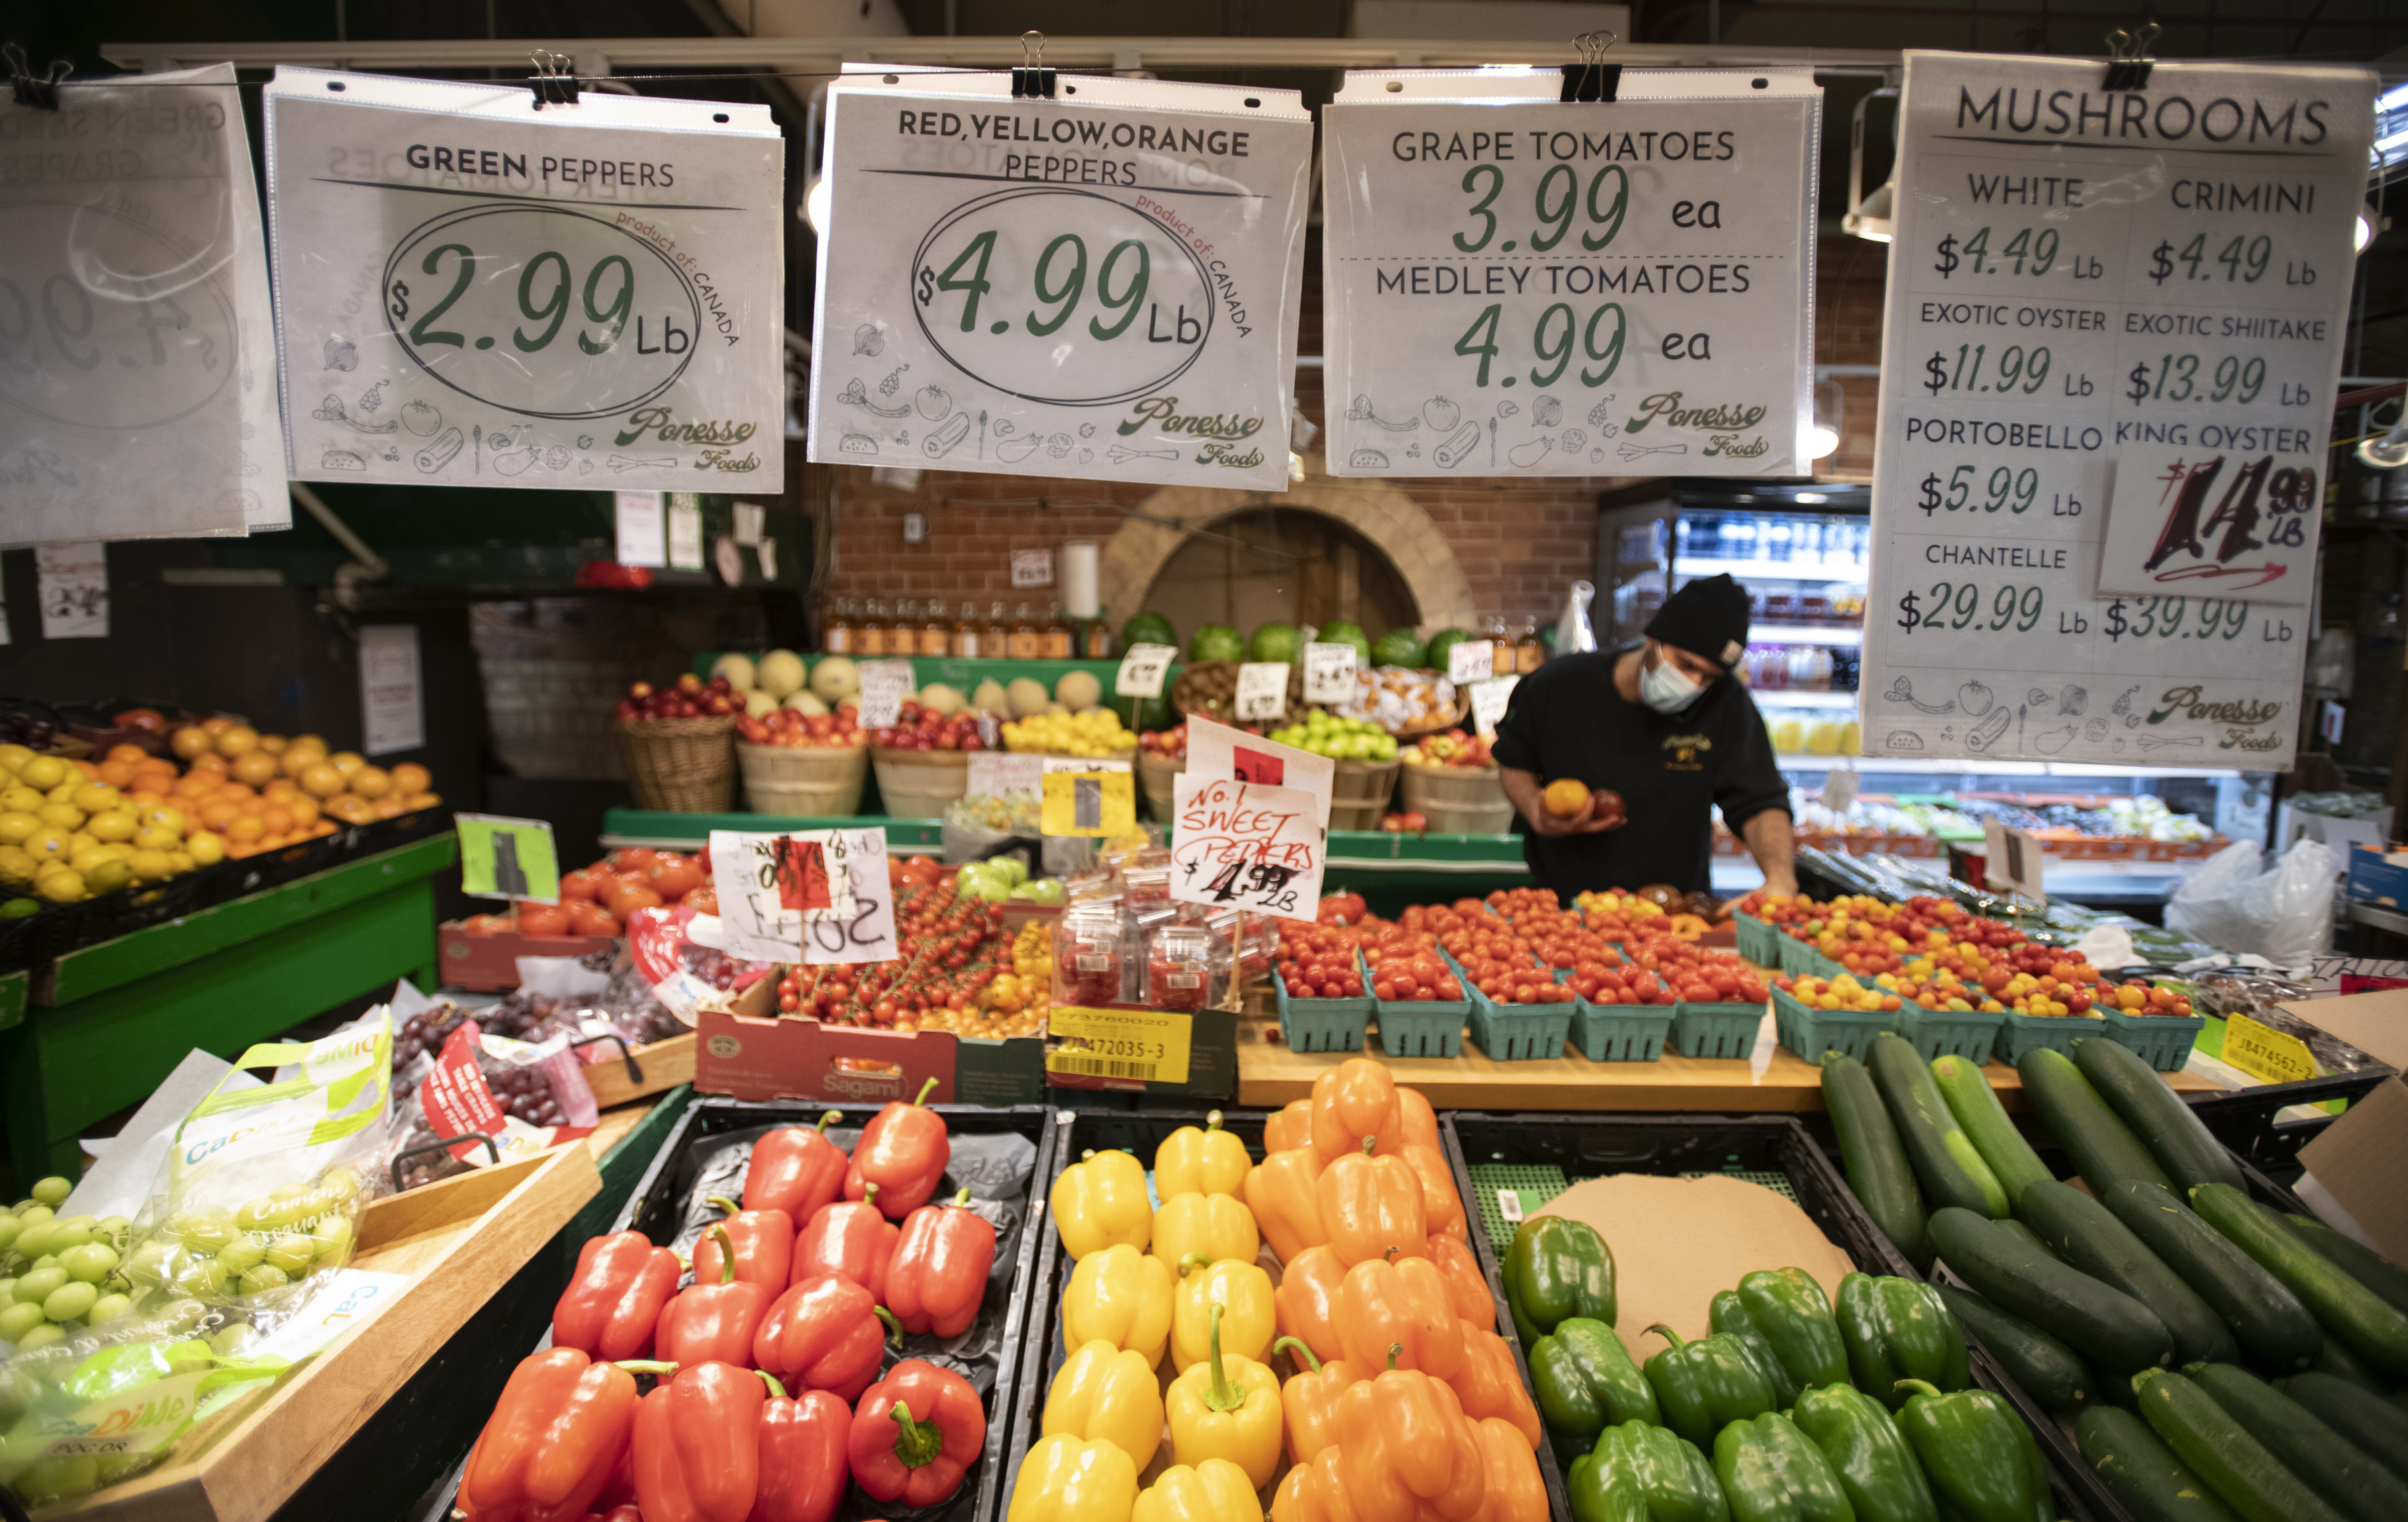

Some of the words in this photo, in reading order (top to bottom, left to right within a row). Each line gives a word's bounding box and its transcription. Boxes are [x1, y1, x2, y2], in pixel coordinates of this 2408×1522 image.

[899, 110, 1249, 157] RED,YELLOW,ORANGE
[1957, 84, 2329, 145] MUSHROOMS
[407, 144, 525, 178] GREEN
[543, 157, 674, 187] PEPPERS
[1393, 131, 1514, 162] GRAPE
[1530, 131, 1735, 161] TOMATOES
[1006, 156, 1136, 185] PEPPERS
[1968, 173, 2084, 208] WHITE
[1452, 164, 1629, 253] 3.99
[1671, 199, 1722, 229] ea
[2171, 180, 2314, 213] CRIMINI
[1134, 194, 1194, 238] product
[1210, 260, 1253, 337] CANADA
[1934, 226, 2060, 280] $4.49
[2074, 256, 2103, 279] Lb
[2149, 232, 2272, 287] $4.49
[2286, 262, 2316, 286] Lb
[615, 211, 676, 253] product
[695, 273, 740, 348] CANADA
[1377, 266, 1531, 295] MEDLEY
[1550, 265, 1750, 294] TOMATOES
[638, 315, 689, 354] Lb
[1148, 302, 1201, 344] Lb
[1921, 302, 2009, 326] EXOTIC
[2017, 307, 2106, 331] OYSTER
[2125, 313, 2212, 336] EXOTIC
[2221, 317, 2327, 341] SHIITAKE
[1454, 302, 1627, 388] 4.99
[1661, 332, 1711, 360] ea
[1924, 343, 2051, 396] $11.99
[2065, 374, 2094, 397] Lb
[2126, 354, 2267, 405] $13.99
[2281, 383, 2311, 406] Lb
[614, 407, 756, 447] Ponesse
[1116, 396, 1264, 439] Ponesse
[1624, 391, 1767, 433] Ponesse
[1703, 434, 1769, 458] Foods
[1906, 418, 2103, 452] PORTOBELLO
[2116, 421, 2188, 446] KING
[2200, 426, 2310, 453] OYSTER
[693, 449, 761, 473] Foods
[1195, 444, 1264, 467] Foods
[1919, 465, 2039, 517] $5.99
[2054, 493, 2082, 516] Lb
[1925, 544, 2067, 569] CHANTELLE
[1897, 582, 2044, 634] $29.99
[2060, 612, 2088, 634] Lb
[2104, 595, 2249, 642] $39.99
[2263, 619, 2293, 642] Lb
[2146, 685, 2282, 725] Ponesse
[2219, 728, 2283, 752] Foods
[1183, 809, 1302, 846] SWEET
[823, 1073, 900, 1100] Sagami
